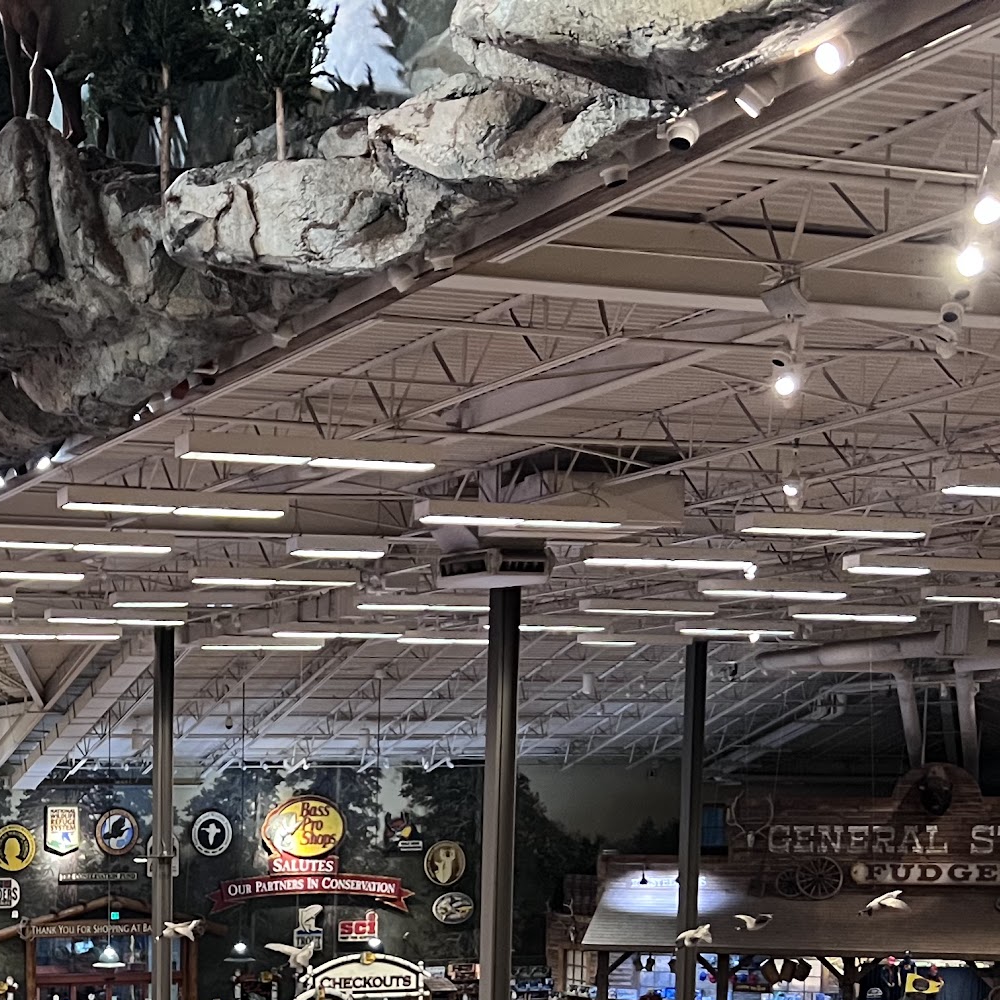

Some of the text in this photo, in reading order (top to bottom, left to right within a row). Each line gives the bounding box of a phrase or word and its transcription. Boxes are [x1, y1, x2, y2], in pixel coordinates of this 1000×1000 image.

[300, 802, 330, 817] Bass
[303, 817, 323, 831] Pro
[300, 831, 337, 848] Shops
[768, 824, 948, 854] GENERAL
[272, 858, 334, 873] SALUTES
[865, 863, 998, 882] FUDGE
[228, 876, 396, 896] OUR PARTNERS IN CONSERVATION
[32, 925, 57, 935] THANK
[58, 924, 75, 934] YOU
[77, 924, 91, 933] FOR
[93, 923, 130, 934] SHOPPING
[131, 923, 141, 932] AT
[321, 975, 412, 989] CHECKOUTS
